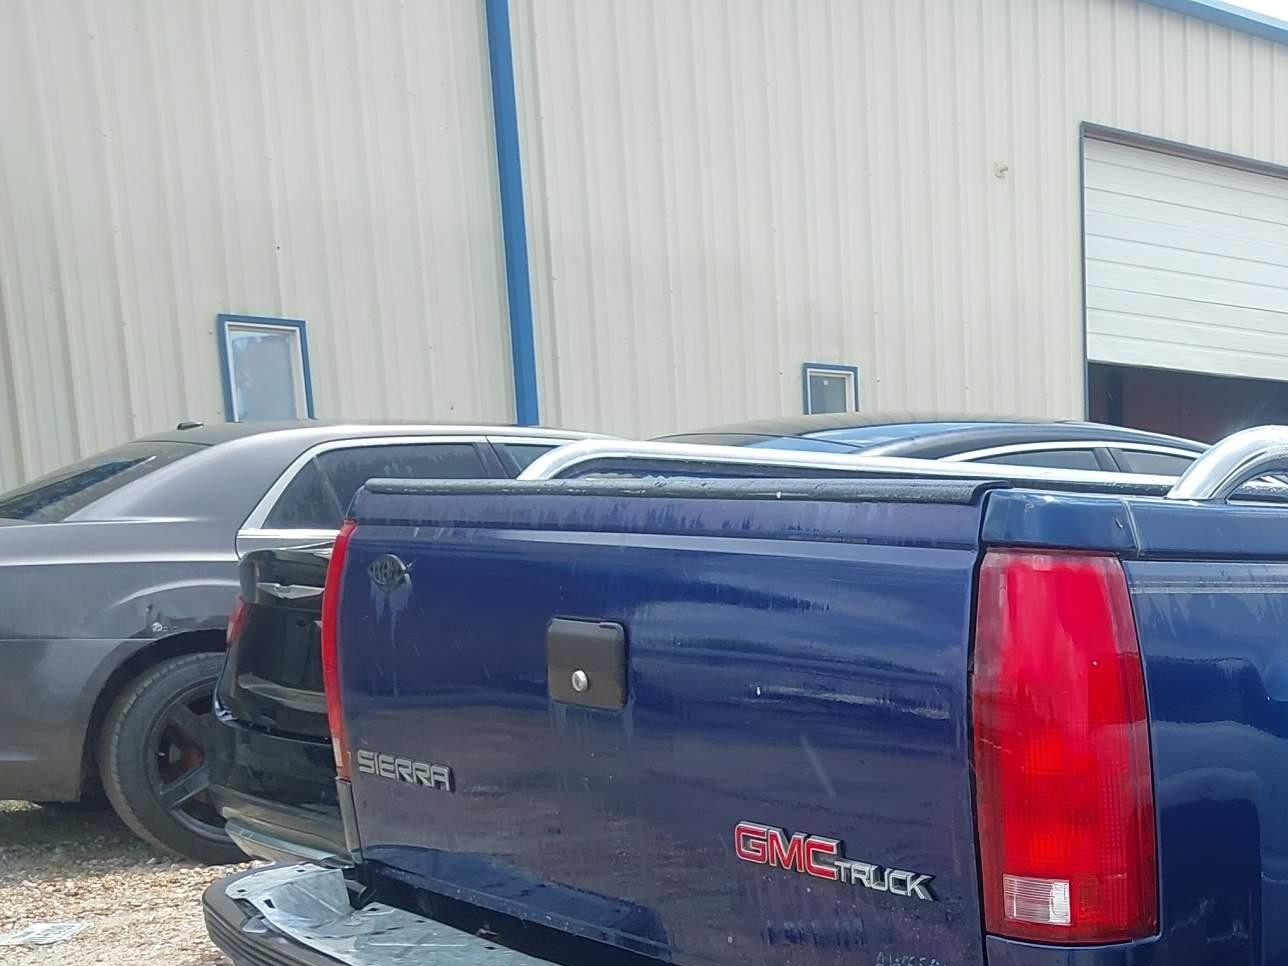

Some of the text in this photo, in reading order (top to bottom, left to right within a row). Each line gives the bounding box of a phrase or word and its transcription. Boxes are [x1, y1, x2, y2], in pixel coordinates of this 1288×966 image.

[357, 749, 451, 792] SIERRA
[735, 821, 934, 901] GMC TRUCK
